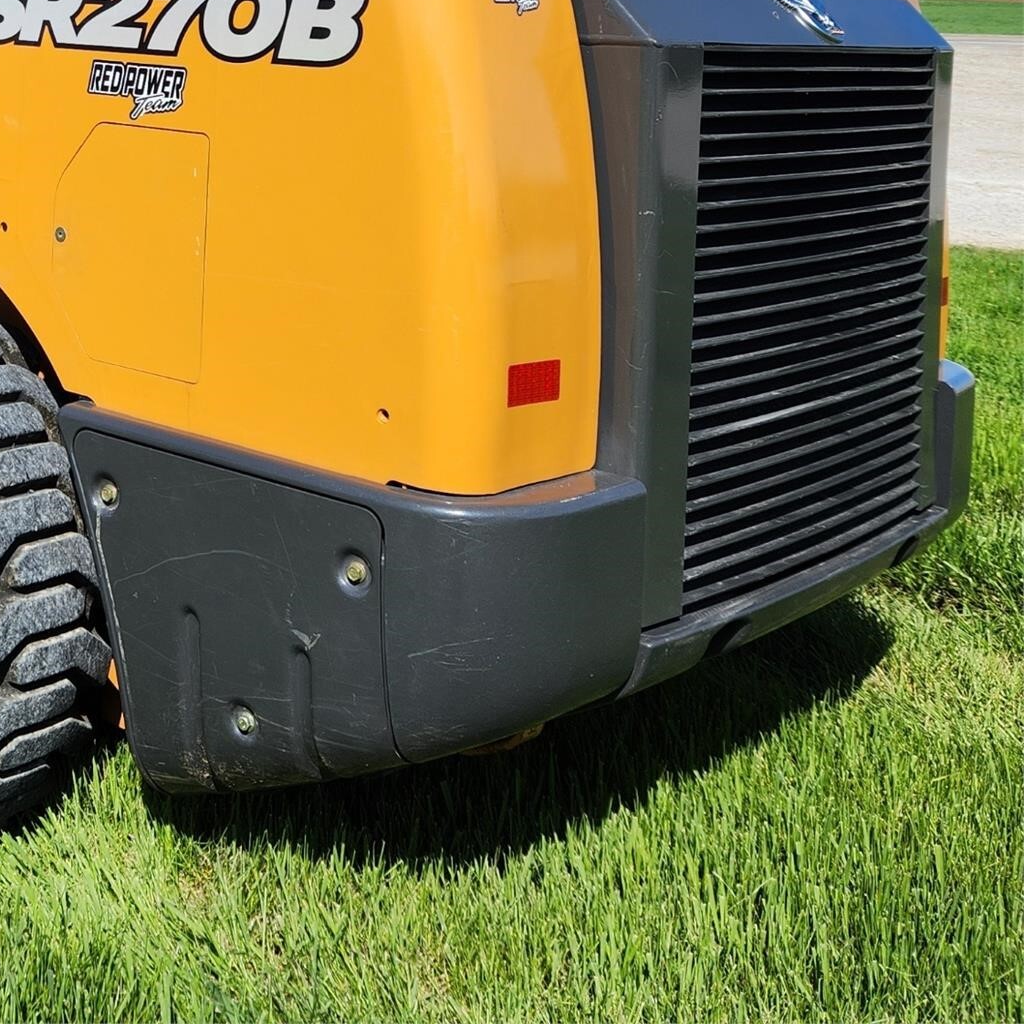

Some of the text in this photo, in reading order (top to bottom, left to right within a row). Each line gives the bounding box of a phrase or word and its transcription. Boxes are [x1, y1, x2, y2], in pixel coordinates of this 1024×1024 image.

[90, 62, 185, 99] RED POWER
[132, 94, 179, 117] Team
